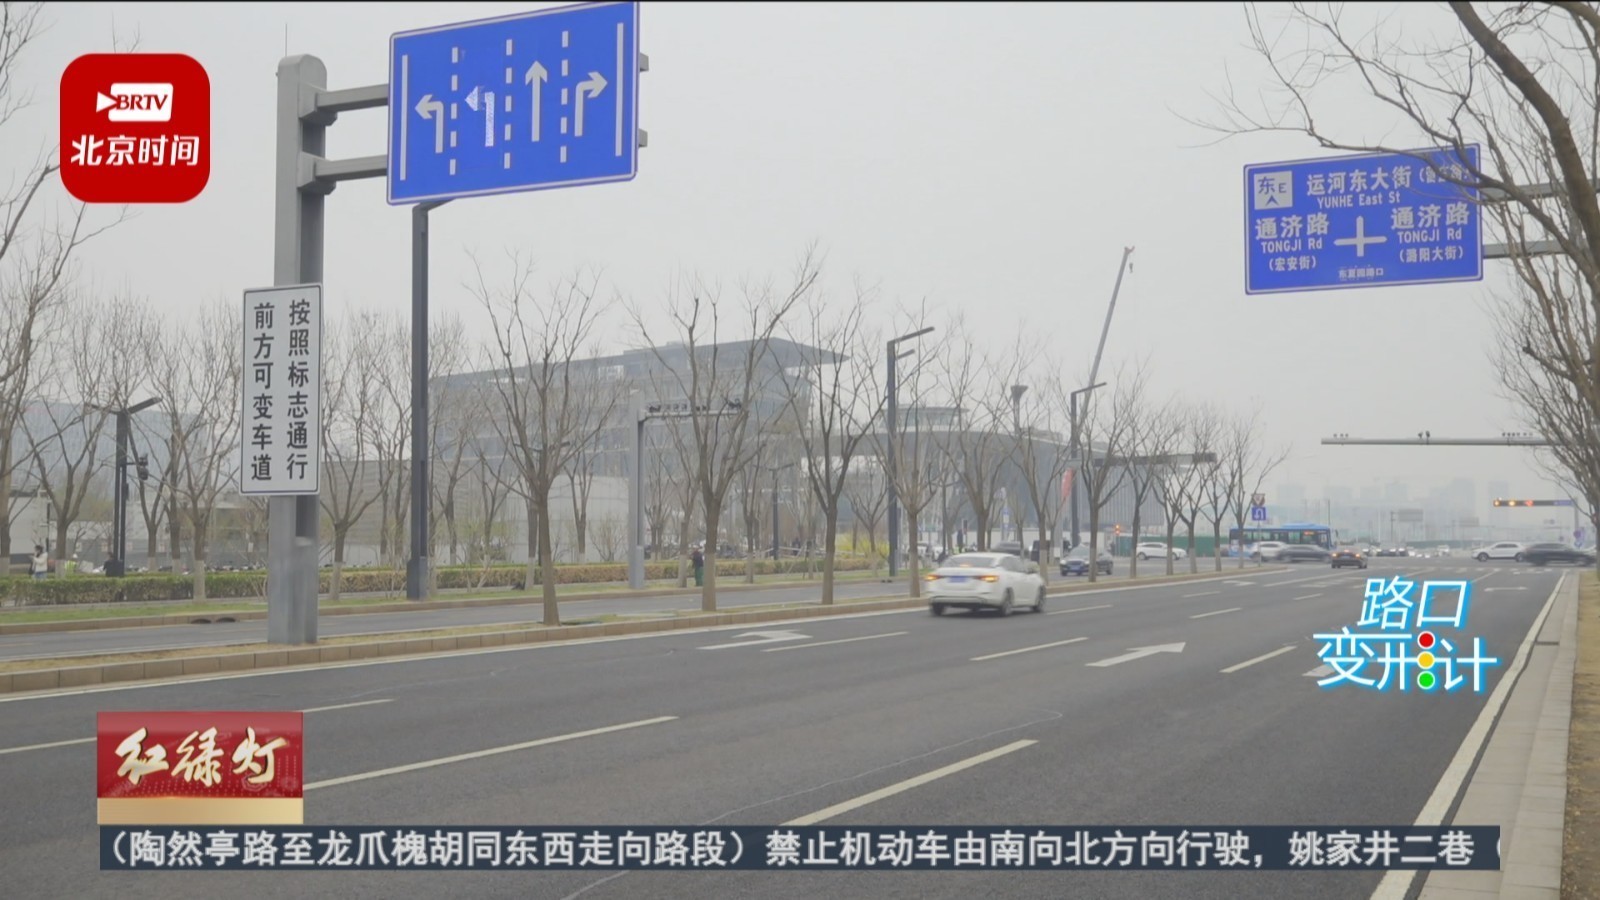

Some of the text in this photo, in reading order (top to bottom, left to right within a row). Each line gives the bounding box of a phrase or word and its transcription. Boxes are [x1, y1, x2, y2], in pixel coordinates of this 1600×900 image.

[1258, 177, 1287, 195] 东 E
[1306, 165, 1412, 197] 运河东大街
[1317, 192, 1401, 209] YUNHE East St
[1255, 212, 1330, 240] 通济路
[1391, 201, 1470, 230] 通济路
[1261, 237, 1323, 254] TONGJI Rd
[1397, 227, 1462, 244] TONGJI Rd
[251, 302, 275, 481] 前方可变车道
[286, 299, 311, 480] 按照标志通行
